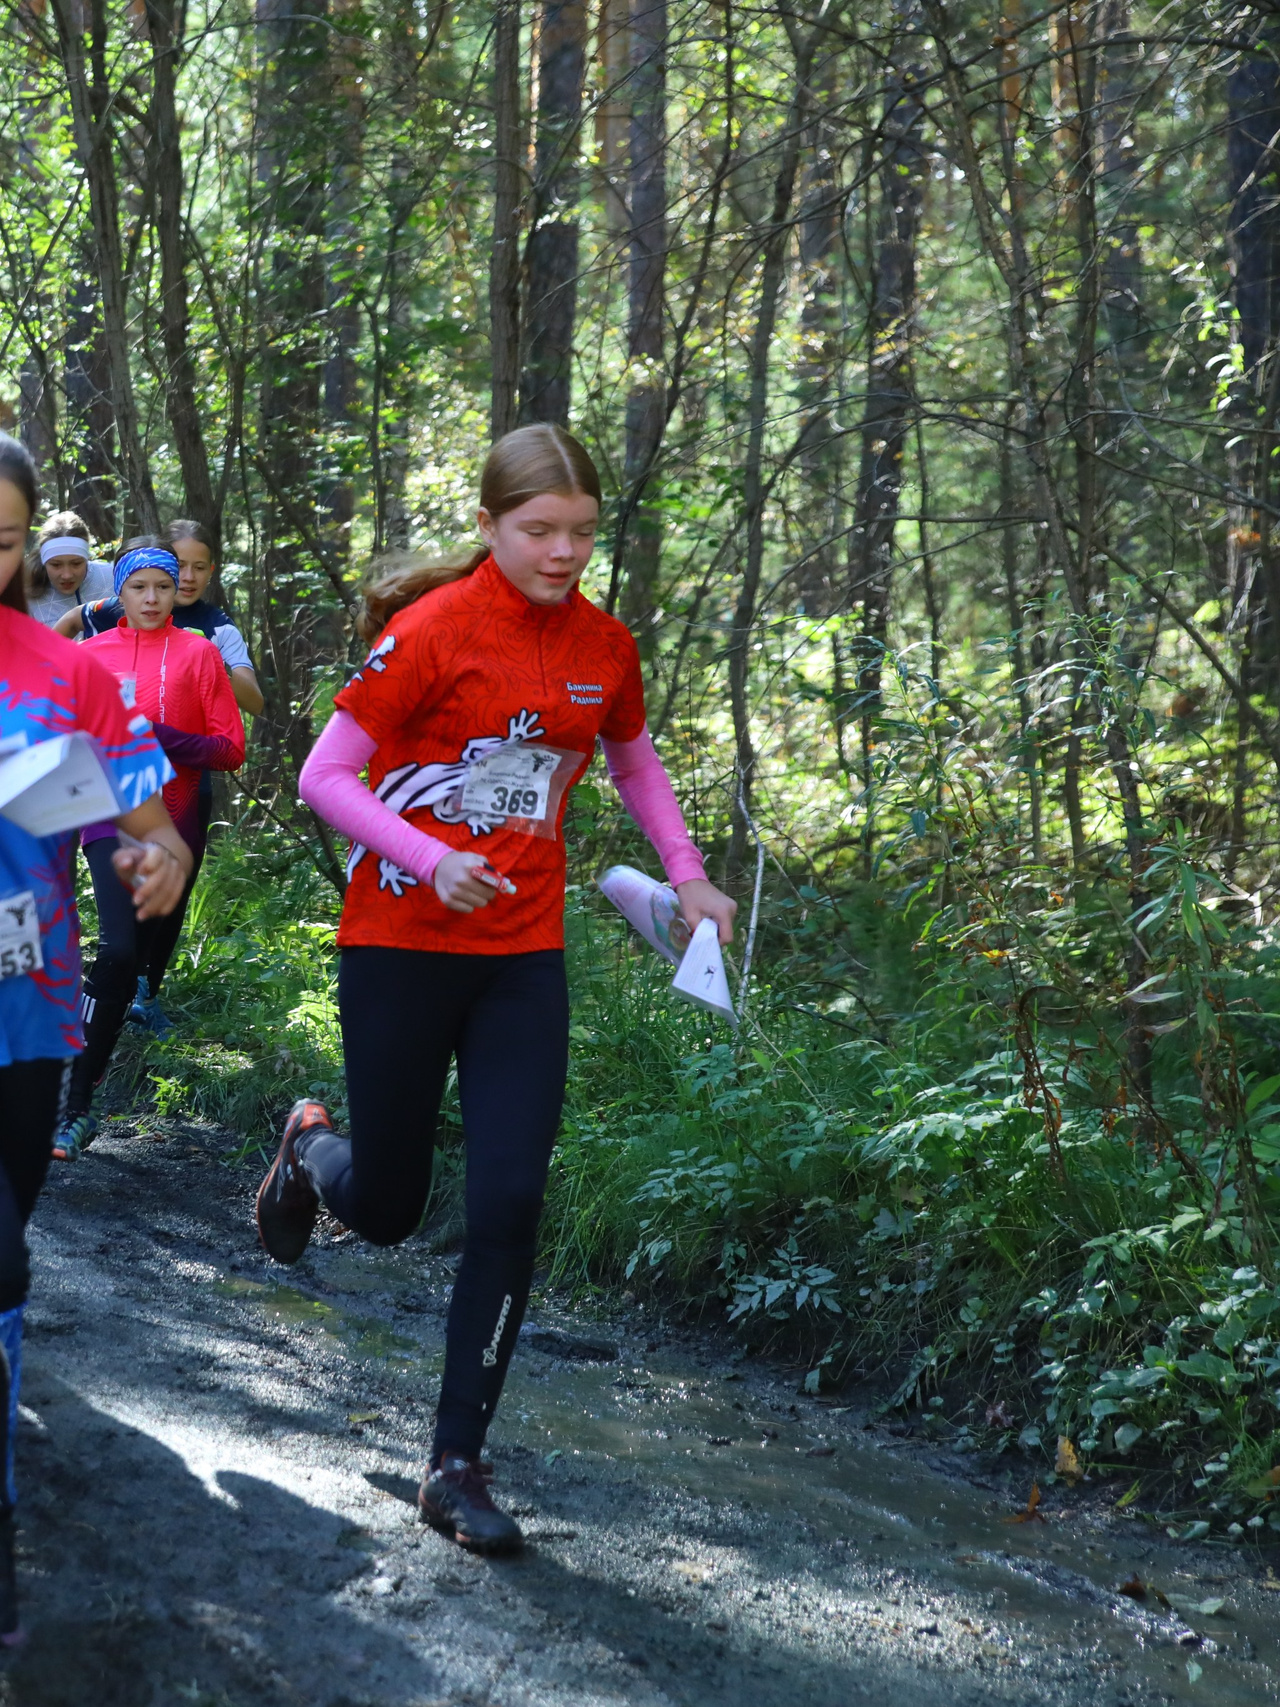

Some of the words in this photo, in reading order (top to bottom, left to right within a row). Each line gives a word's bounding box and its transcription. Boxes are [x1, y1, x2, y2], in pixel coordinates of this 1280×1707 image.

[566, 681, 603, 693] Бакунина
[570, 694, 603, 705] Радмила
[490, 786, 539, 816] 369
